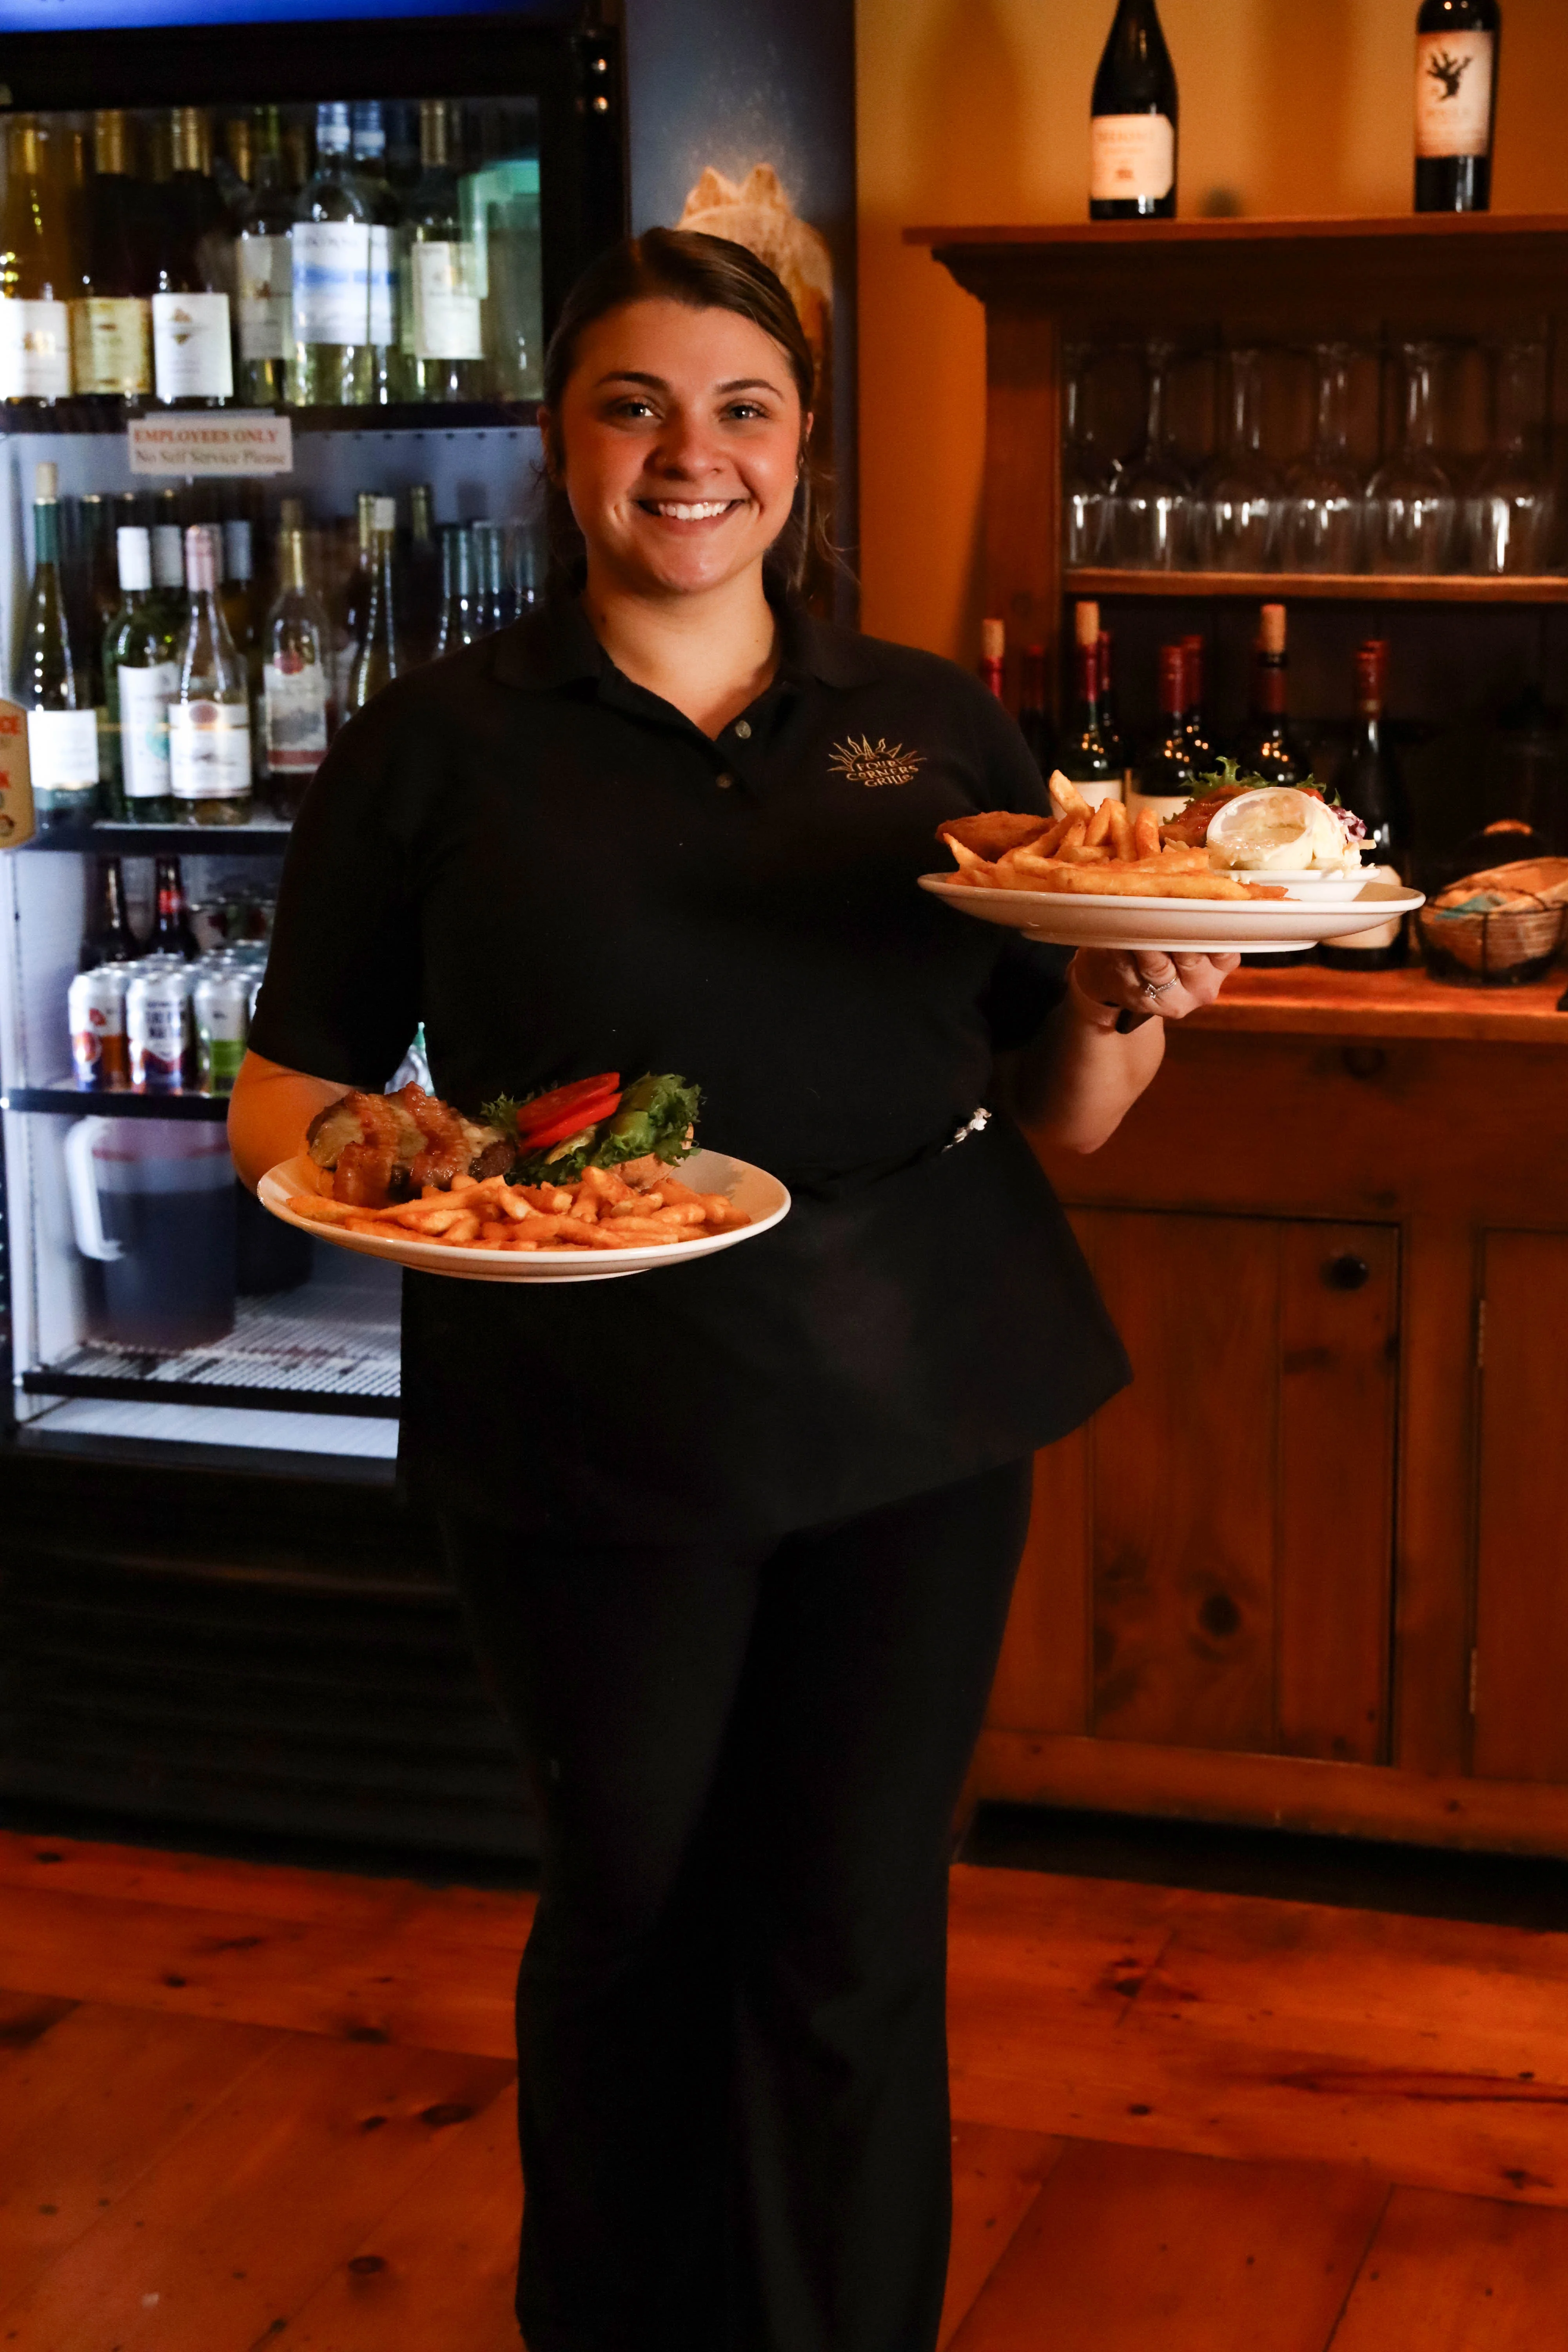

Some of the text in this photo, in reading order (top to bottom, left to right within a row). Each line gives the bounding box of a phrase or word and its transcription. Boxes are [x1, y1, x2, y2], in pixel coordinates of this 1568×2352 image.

[133, 428, 278, 444] EMPLOYEES ONLY
[846, 765, 919, 780] CORNERS
[856, 760, 897, 771] FOUR
